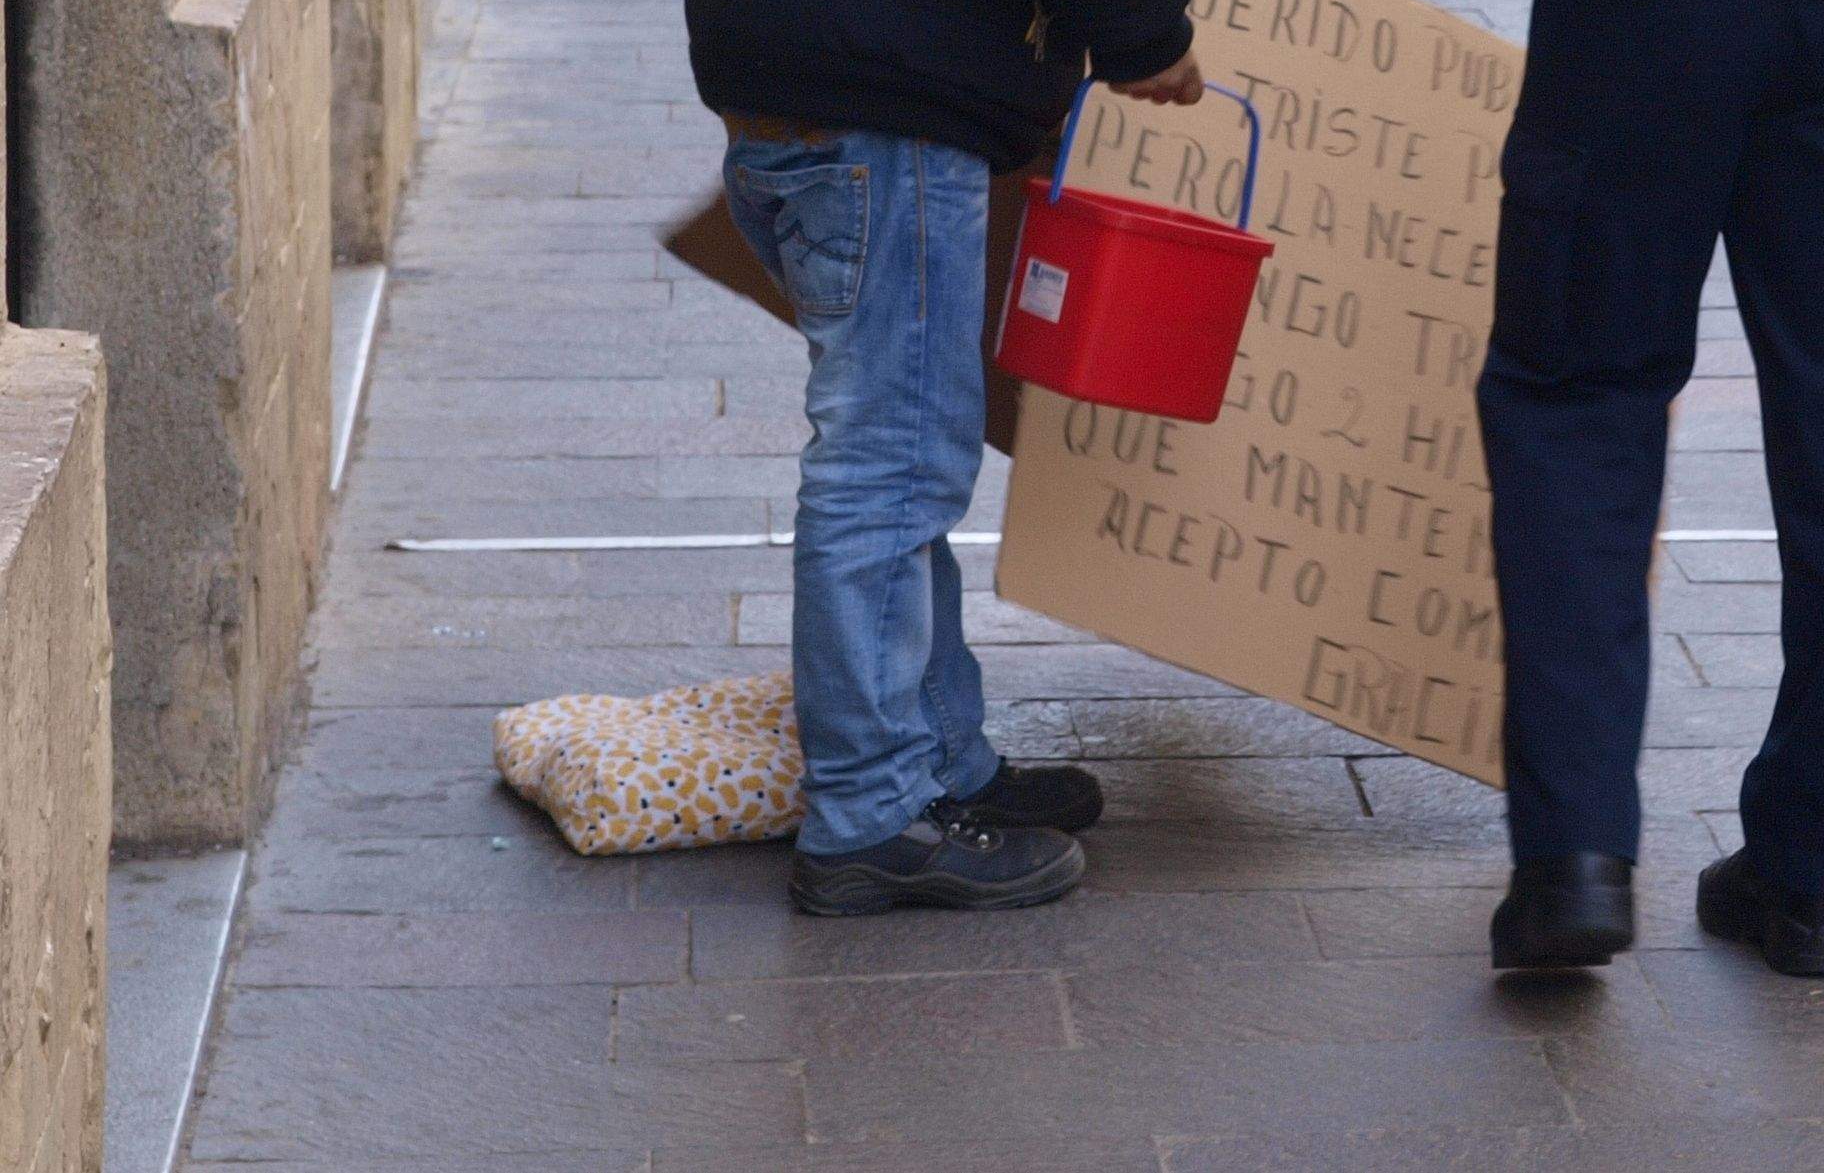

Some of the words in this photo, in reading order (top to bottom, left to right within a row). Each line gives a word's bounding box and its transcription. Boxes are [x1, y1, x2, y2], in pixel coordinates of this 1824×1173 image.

[1427, 25, 1512, 113] PUB
[1086, 102, 1242, 219] PERO
[1364, 201, 1491, 287] NECE
[1234, 70, 1433, 178] TRISTE
[1454, 130, 1498, 204] P
[1257, 266, 1361, 348] NGO
[1406, 309, 1479, 393] TR
[1064, 402, 1179, 475] QUE
[1225, 349, 1298, 426] GO
[1403, 405, 1474, 481] HI
[1096, 485, 1328, 608] ACEPTO
[1368, 569, 1493, 660] COM
